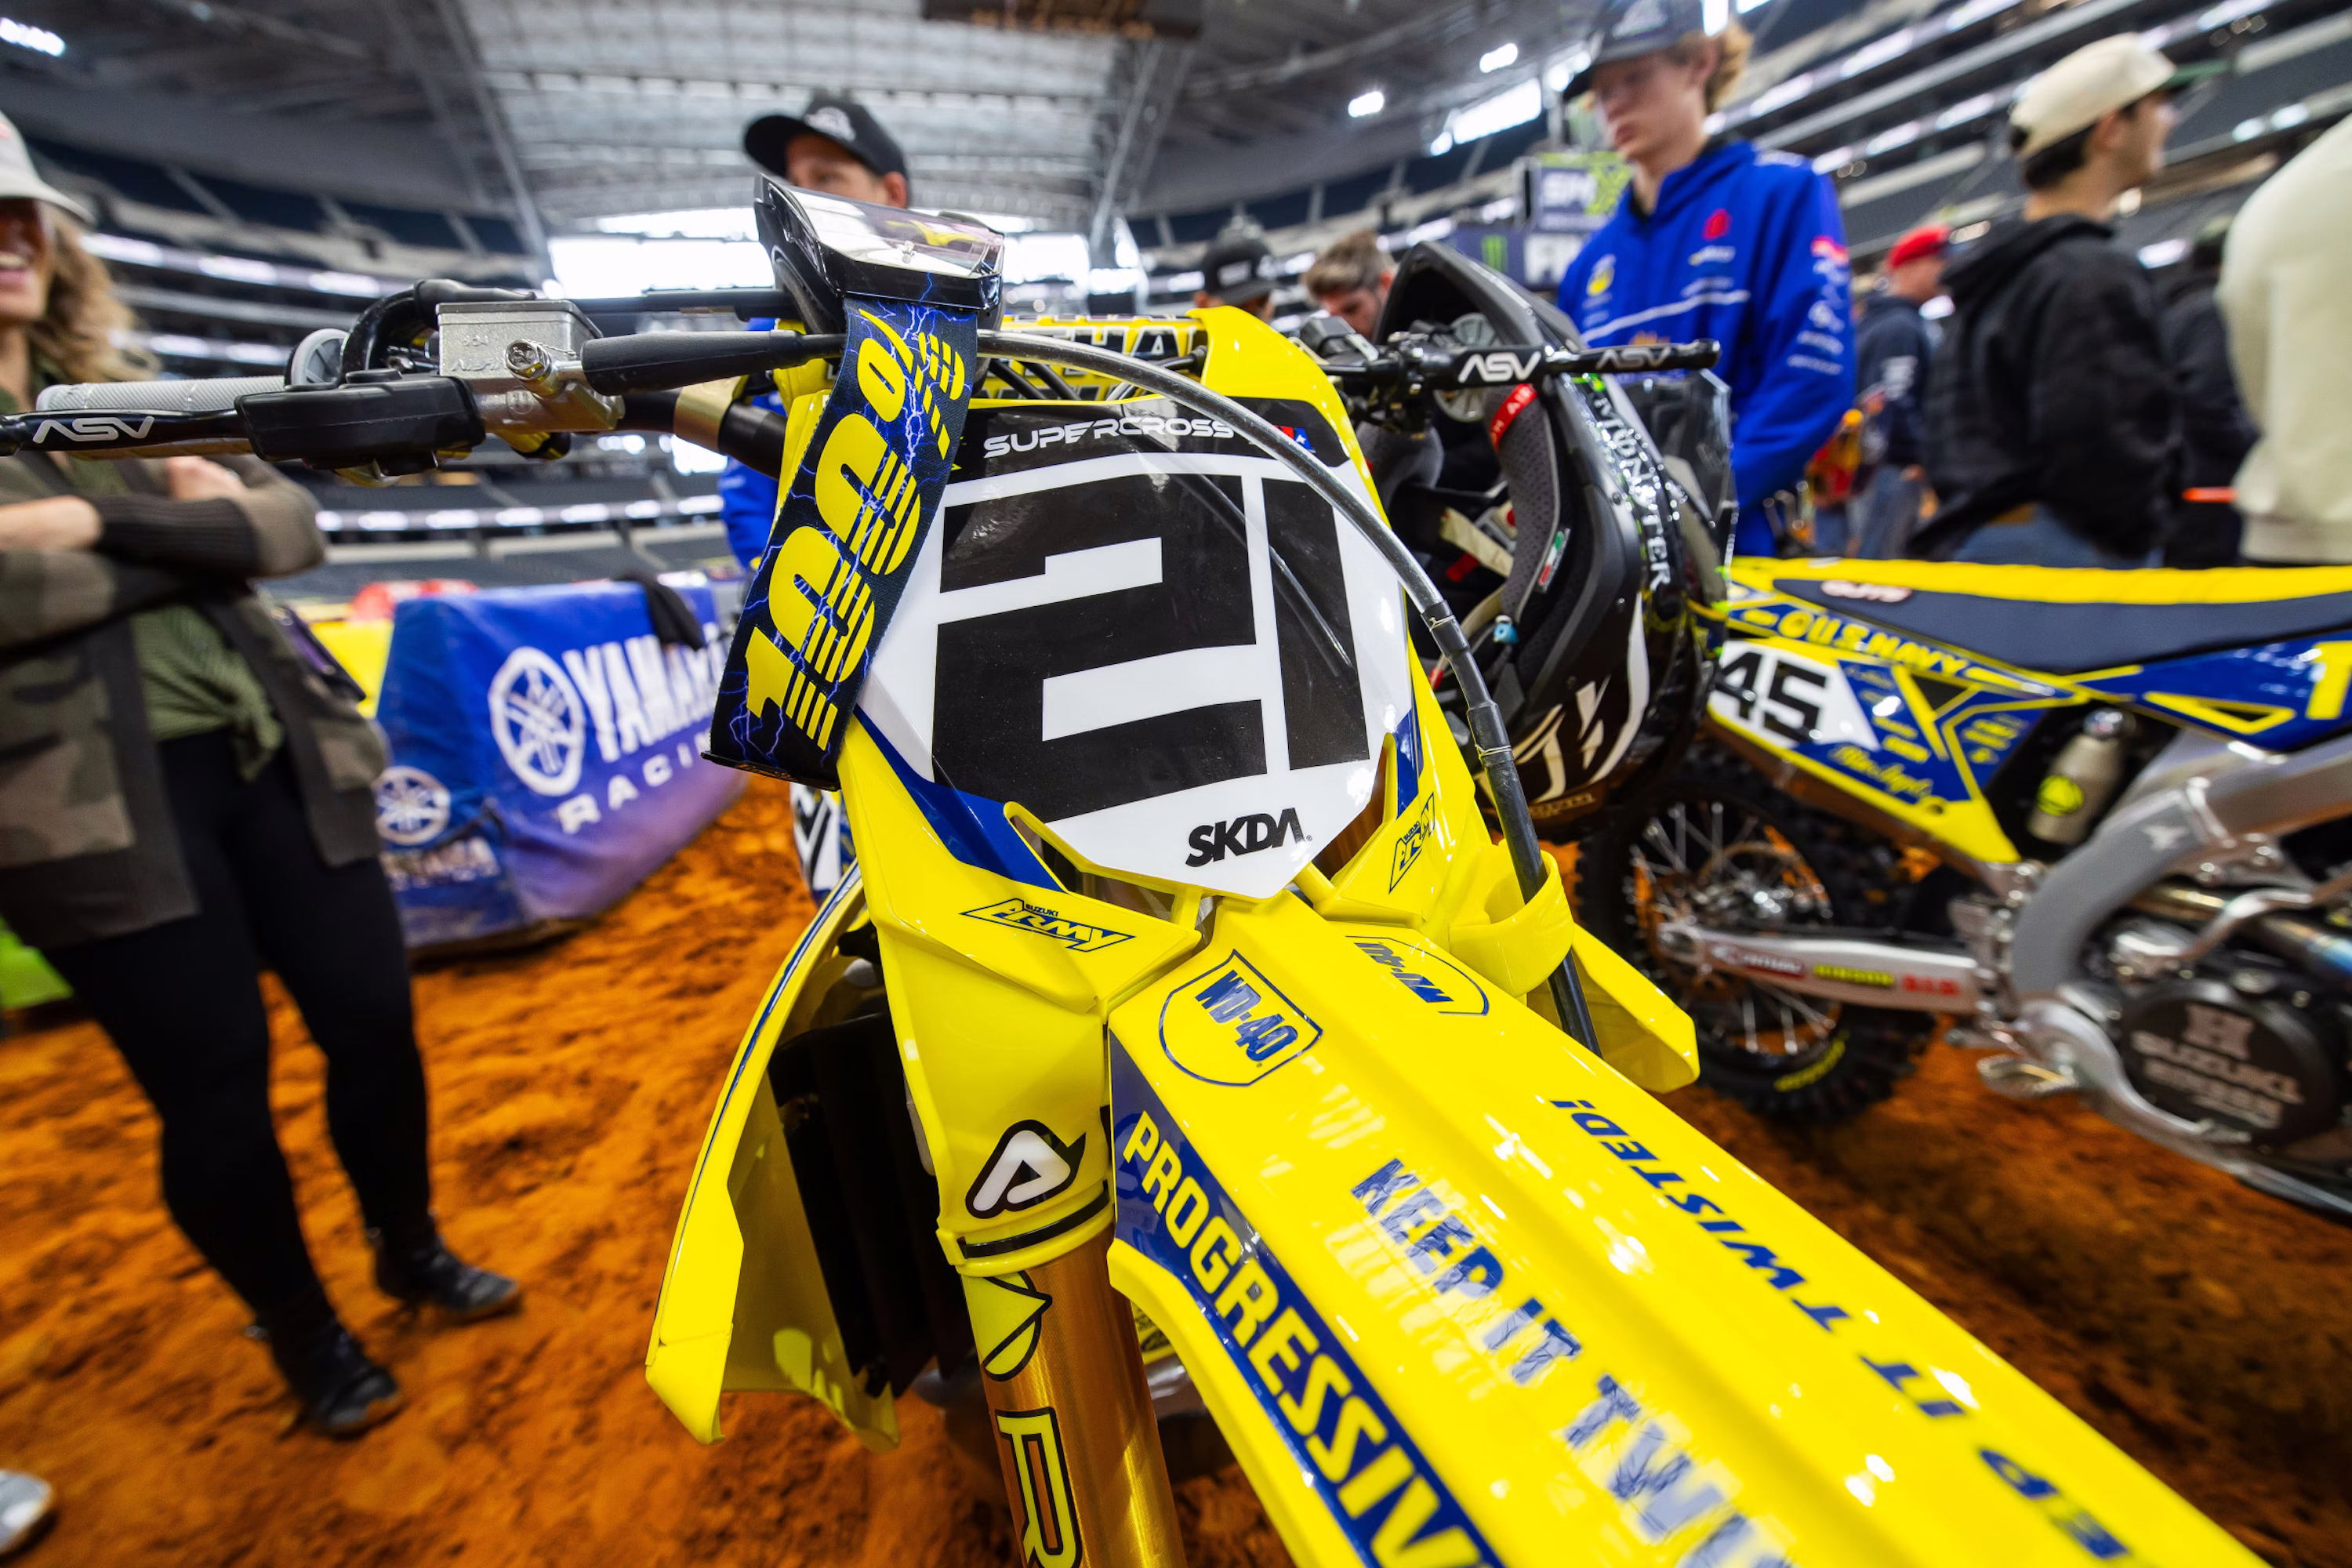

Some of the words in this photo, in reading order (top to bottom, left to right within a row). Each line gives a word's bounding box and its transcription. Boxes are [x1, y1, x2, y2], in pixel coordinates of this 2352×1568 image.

[1458, 351, 1541, 383] ASV
[1595, 347, 1671, 371] ASV
[33, 416, 155, 444] ASV
[983, 416, 1235, 459] SUPERCROSS
[744, 308, 965, 751] 100%
[931, 472, 1370, 824] 21
[1712, 651, 1828, 743] 45
[1185, 807, 1306, 868] SKDA
[958, 897, 1137, 953] ARMY
[1025, 903, 1059, 917] SUZUKI
[1353, 942, 1455, 1004] WD-40
[1195, 969, 1298, 1062] WD-40
[1552, 1099, 1850, 1333] TWISTED!
[1349, 1157, 1505, 1298] KEEP
[1483, 1297, 1582, 1387] IT
[1122, 1110, 1494, 1568] PROGRESSIV
[1858, 1353, 1966, 1418] IT
